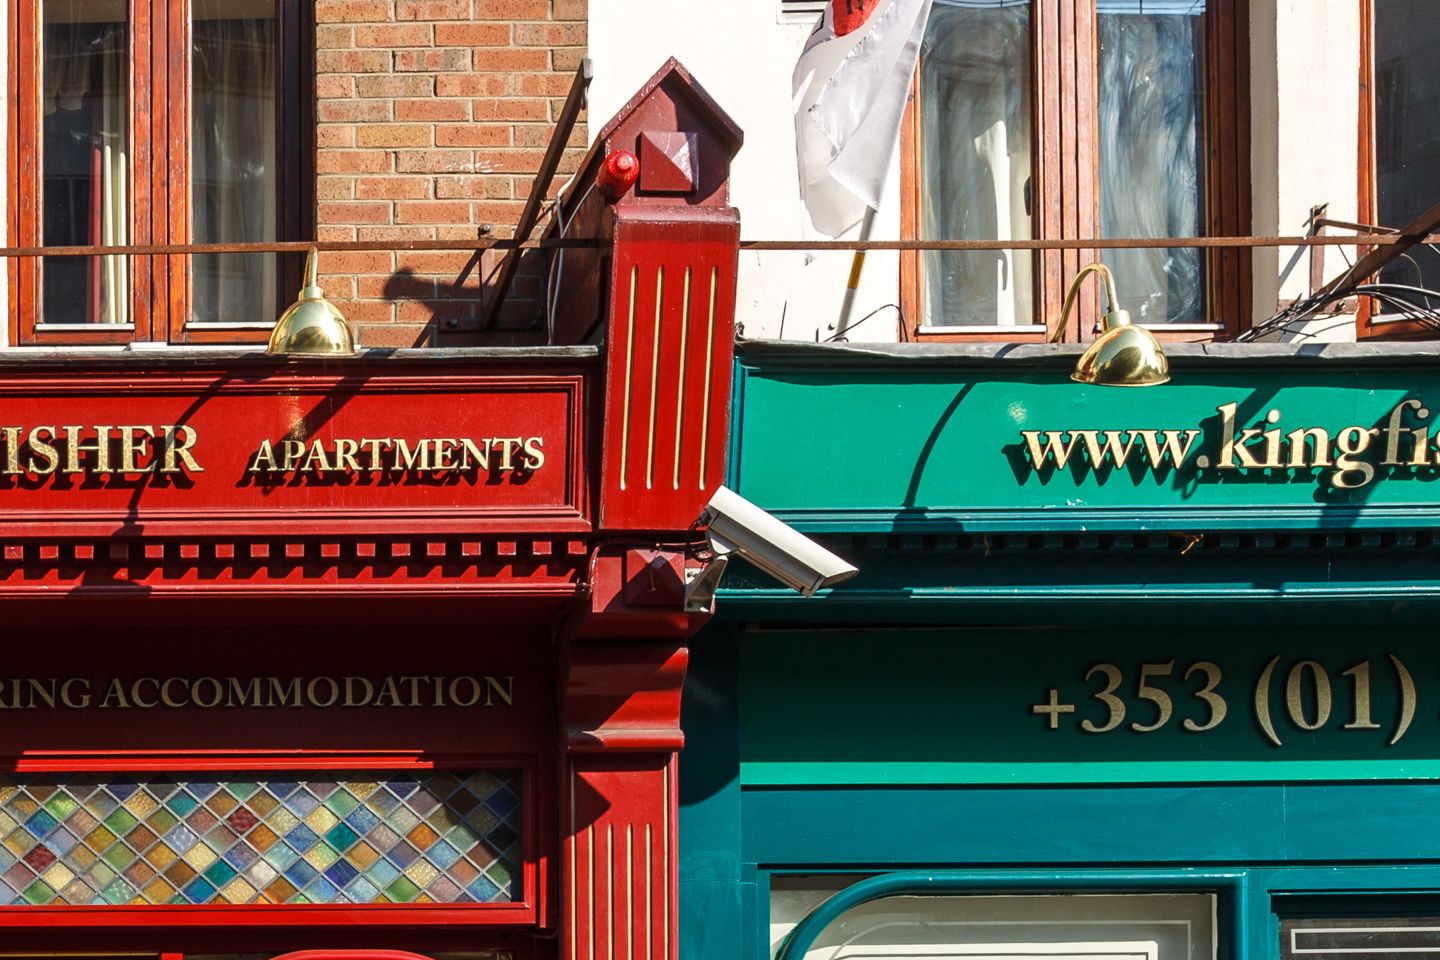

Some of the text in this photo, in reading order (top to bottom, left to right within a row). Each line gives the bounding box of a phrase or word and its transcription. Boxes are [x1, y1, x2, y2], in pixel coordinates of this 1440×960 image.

[248, 436, 546, 471] APARTMENTS
[99, 675, 515, 709] ACCOMMODATION
[1033, 655, 1417, 747] +353 (01)
